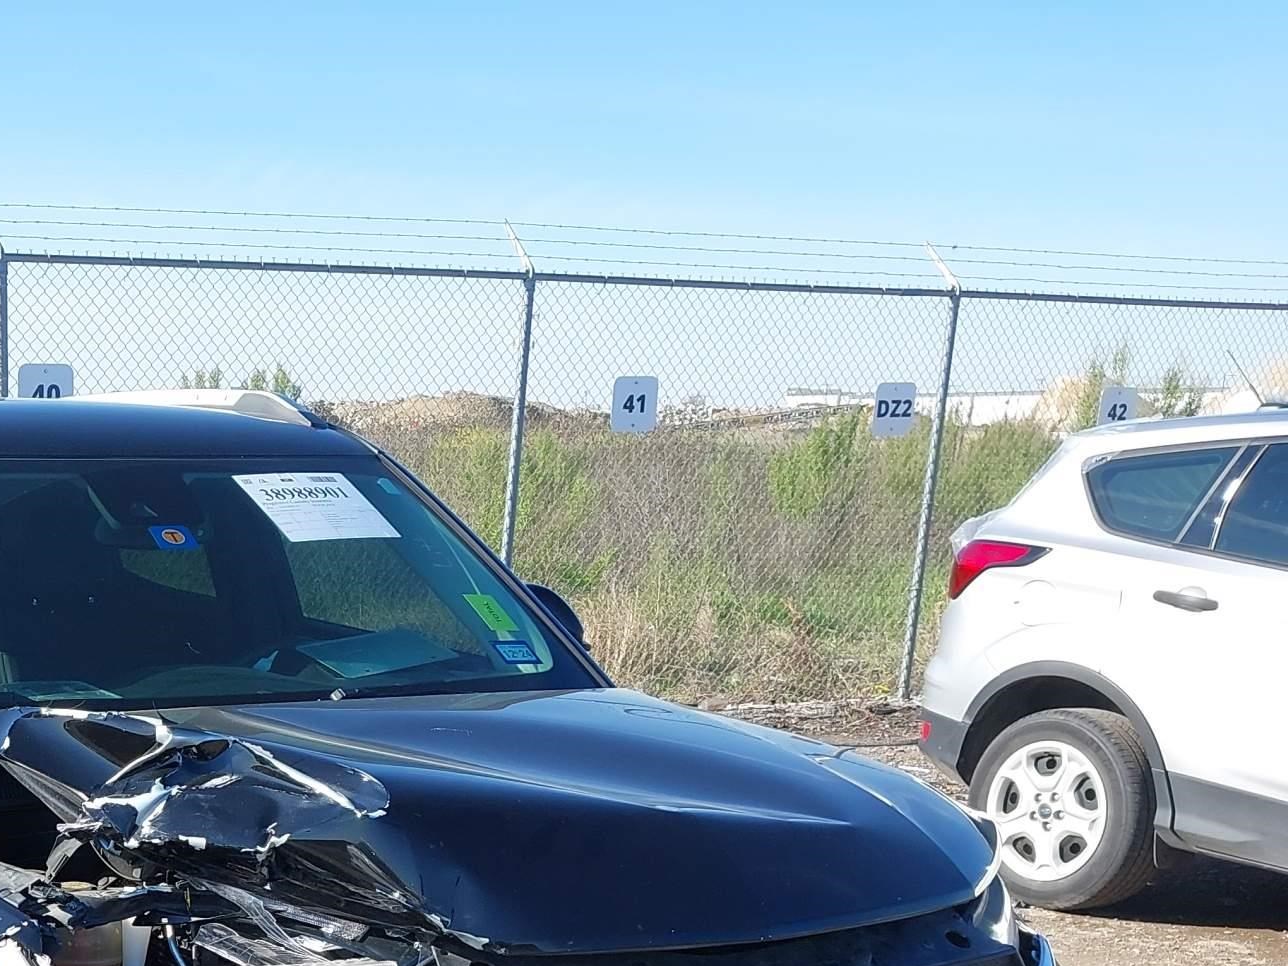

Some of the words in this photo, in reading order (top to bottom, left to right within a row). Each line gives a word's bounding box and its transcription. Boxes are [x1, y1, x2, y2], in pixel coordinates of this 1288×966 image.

[622, 394, 647, 414] 41
[876, 399, 912, 418] DZ2
[1107, 403, 1128, 421] 42
[258, 486, 350, 502] 38988901
